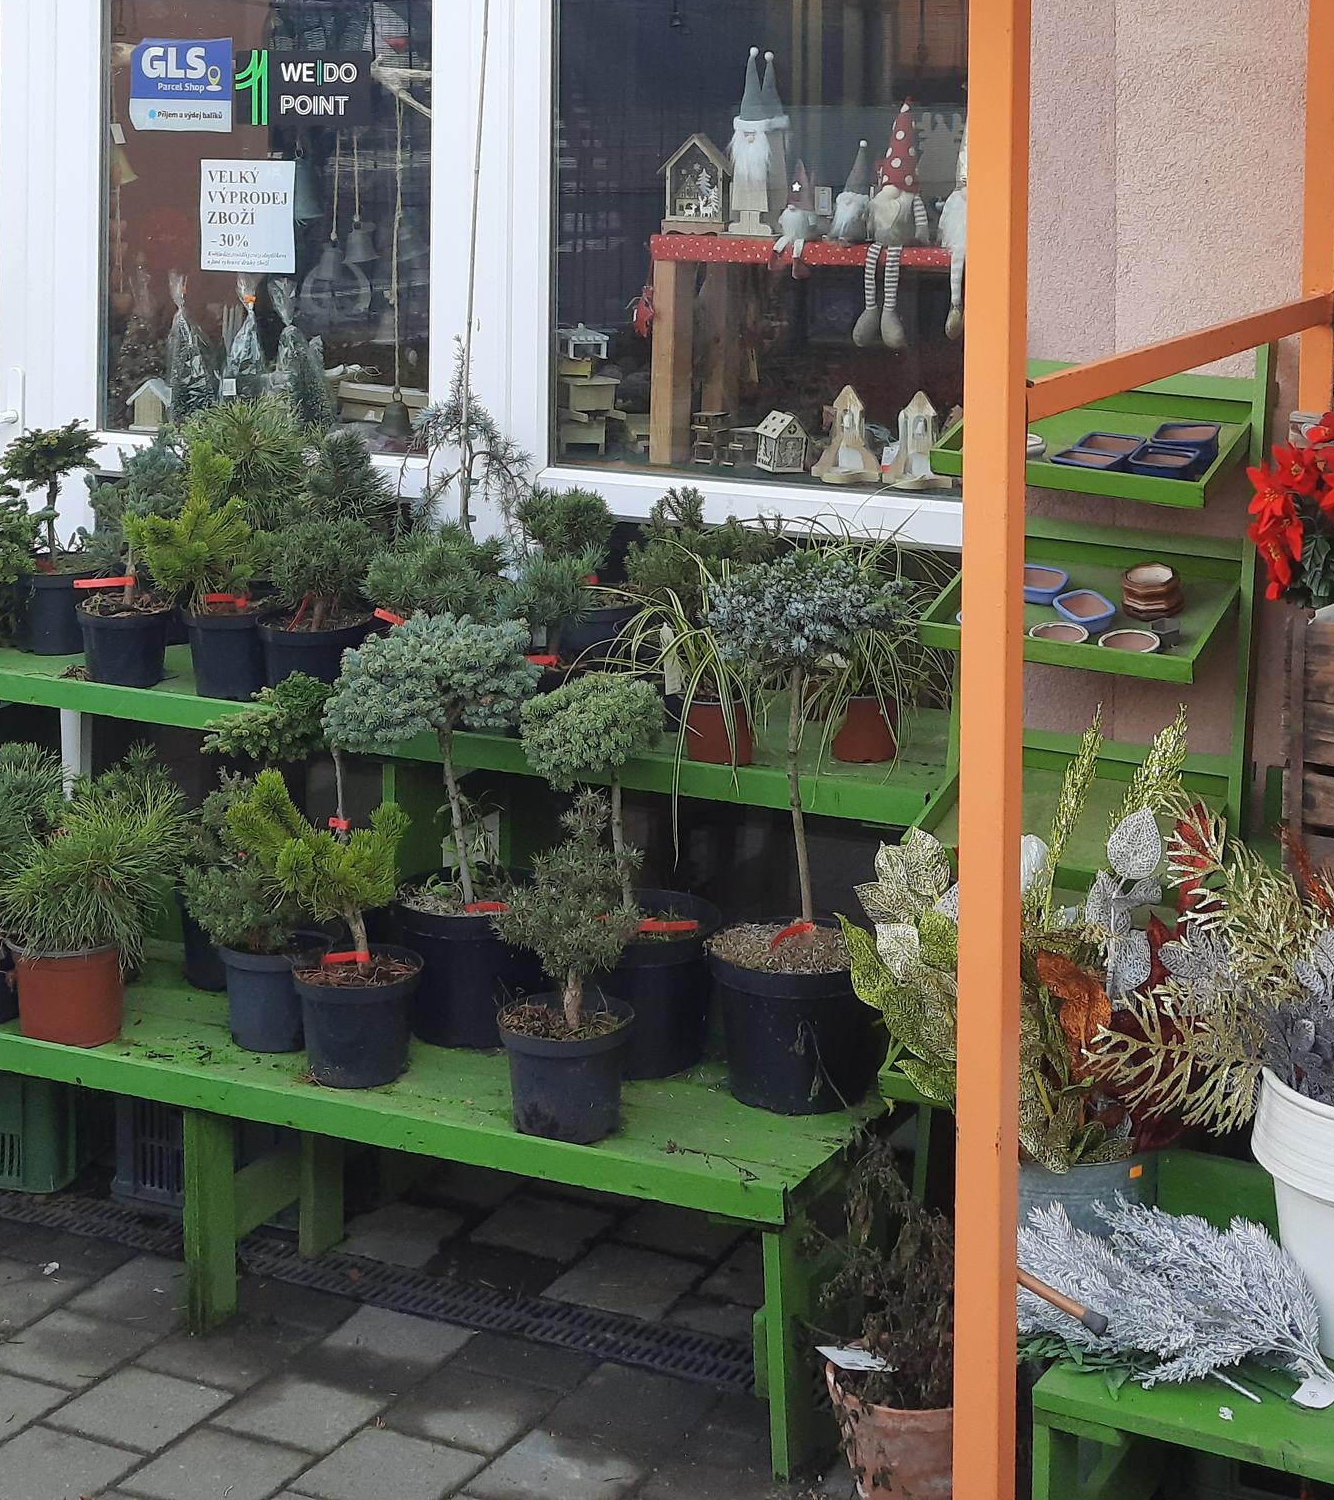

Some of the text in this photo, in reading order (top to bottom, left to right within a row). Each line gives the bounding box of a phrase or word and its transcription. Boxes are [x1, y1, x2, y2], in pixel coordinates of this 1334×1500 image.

[141, 46, 207, 80] GLS
[157, 83, 205, 94] Parcel Shop
[280, 95, 350, 116] POINT
[184, 111, 202, 121] výdej
[203, 111, 223, 120] balíků
[208, 167, 260, 184] VELKÝ
[208, 187, 288, 205] VÝPRODEJ
[207, 208, 255, 225] ZBOŽÍ
